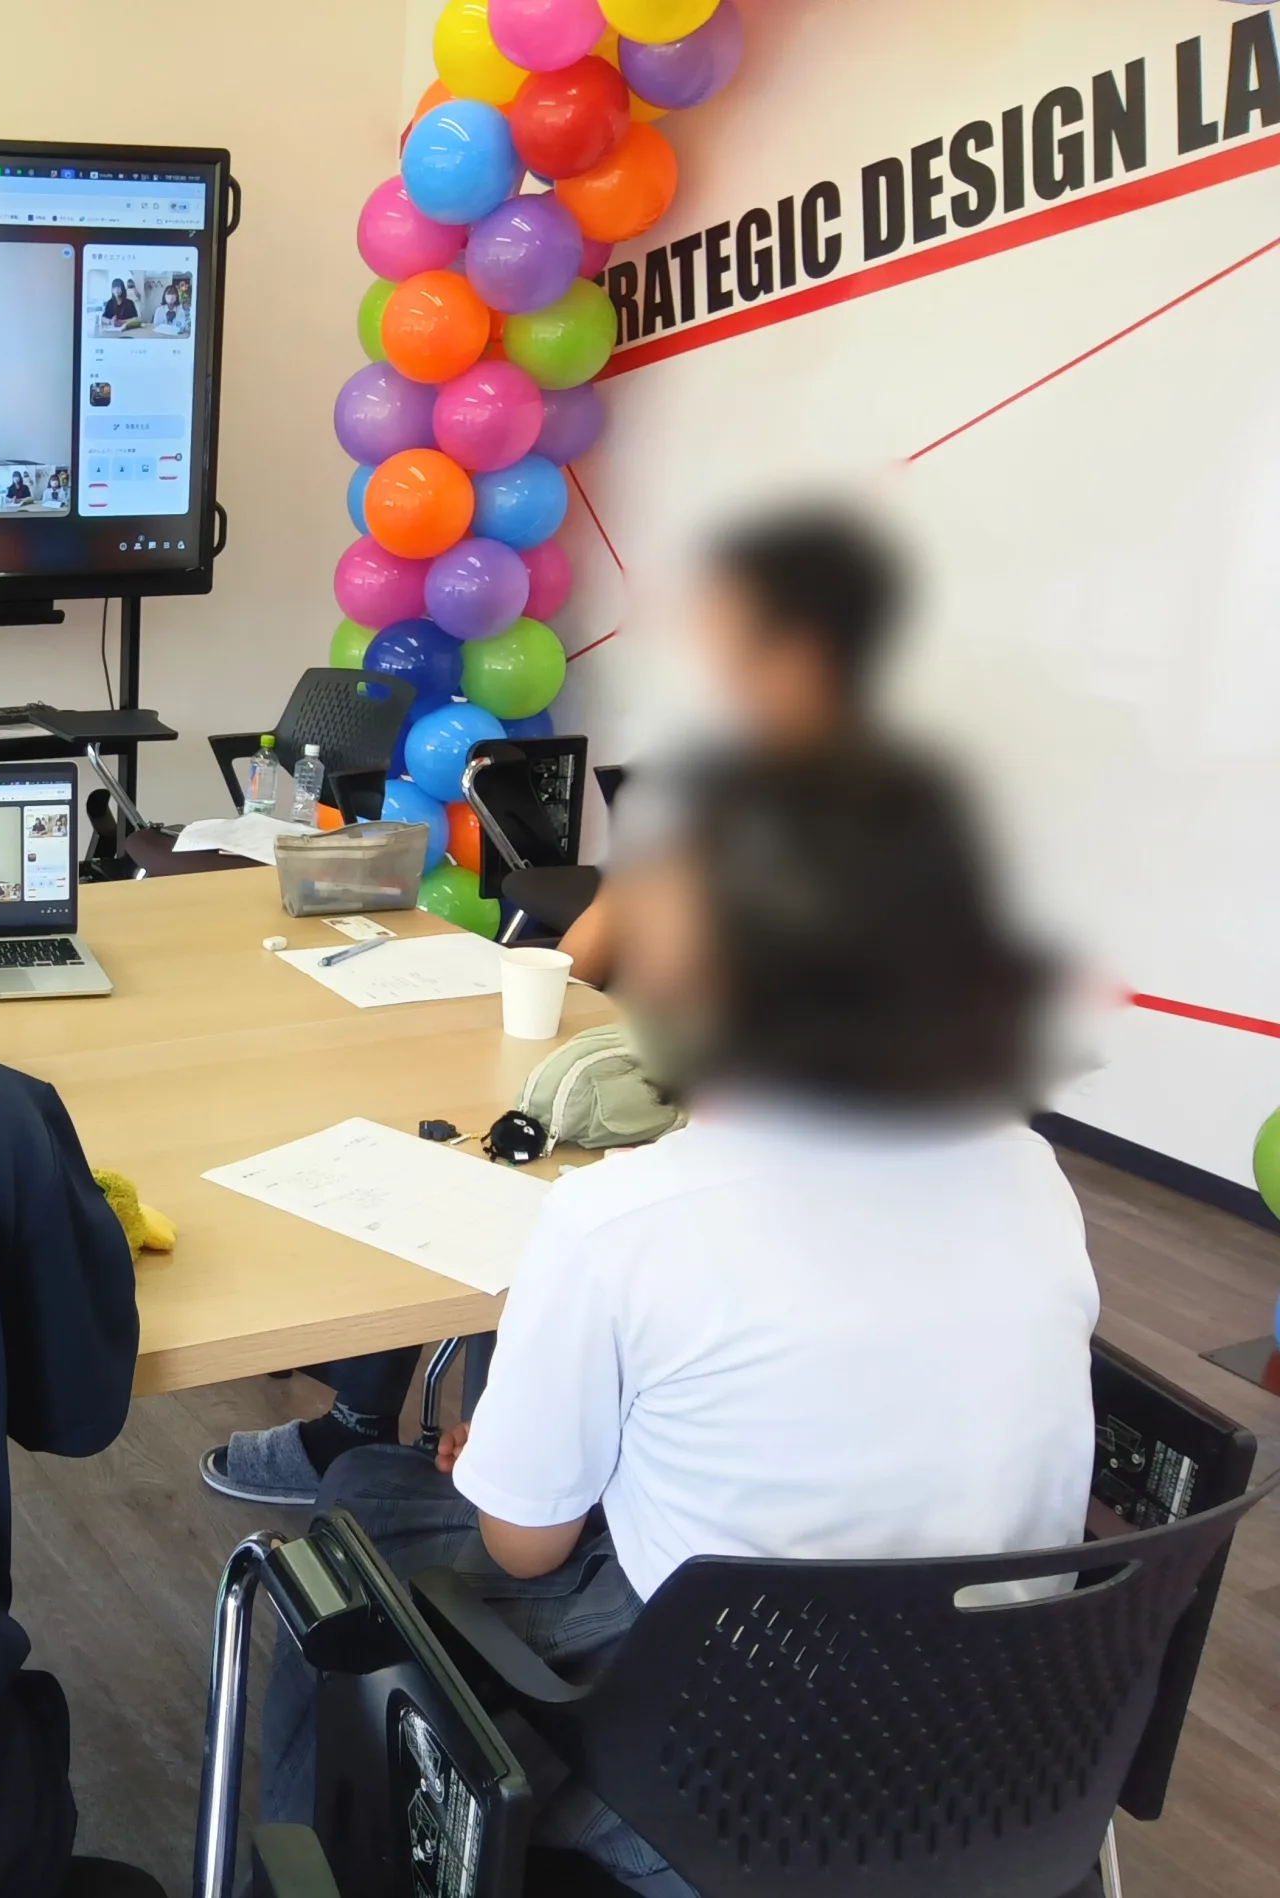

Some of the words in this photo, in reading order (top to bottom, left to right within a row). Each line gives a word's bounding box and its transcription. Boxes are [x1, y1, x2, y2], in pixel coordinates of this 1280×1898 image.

[594, 180, 841, 347] RATEGIC
[861, 57, 1146, 262] DESIGN
[1176, 9, 1280, 156] LA
